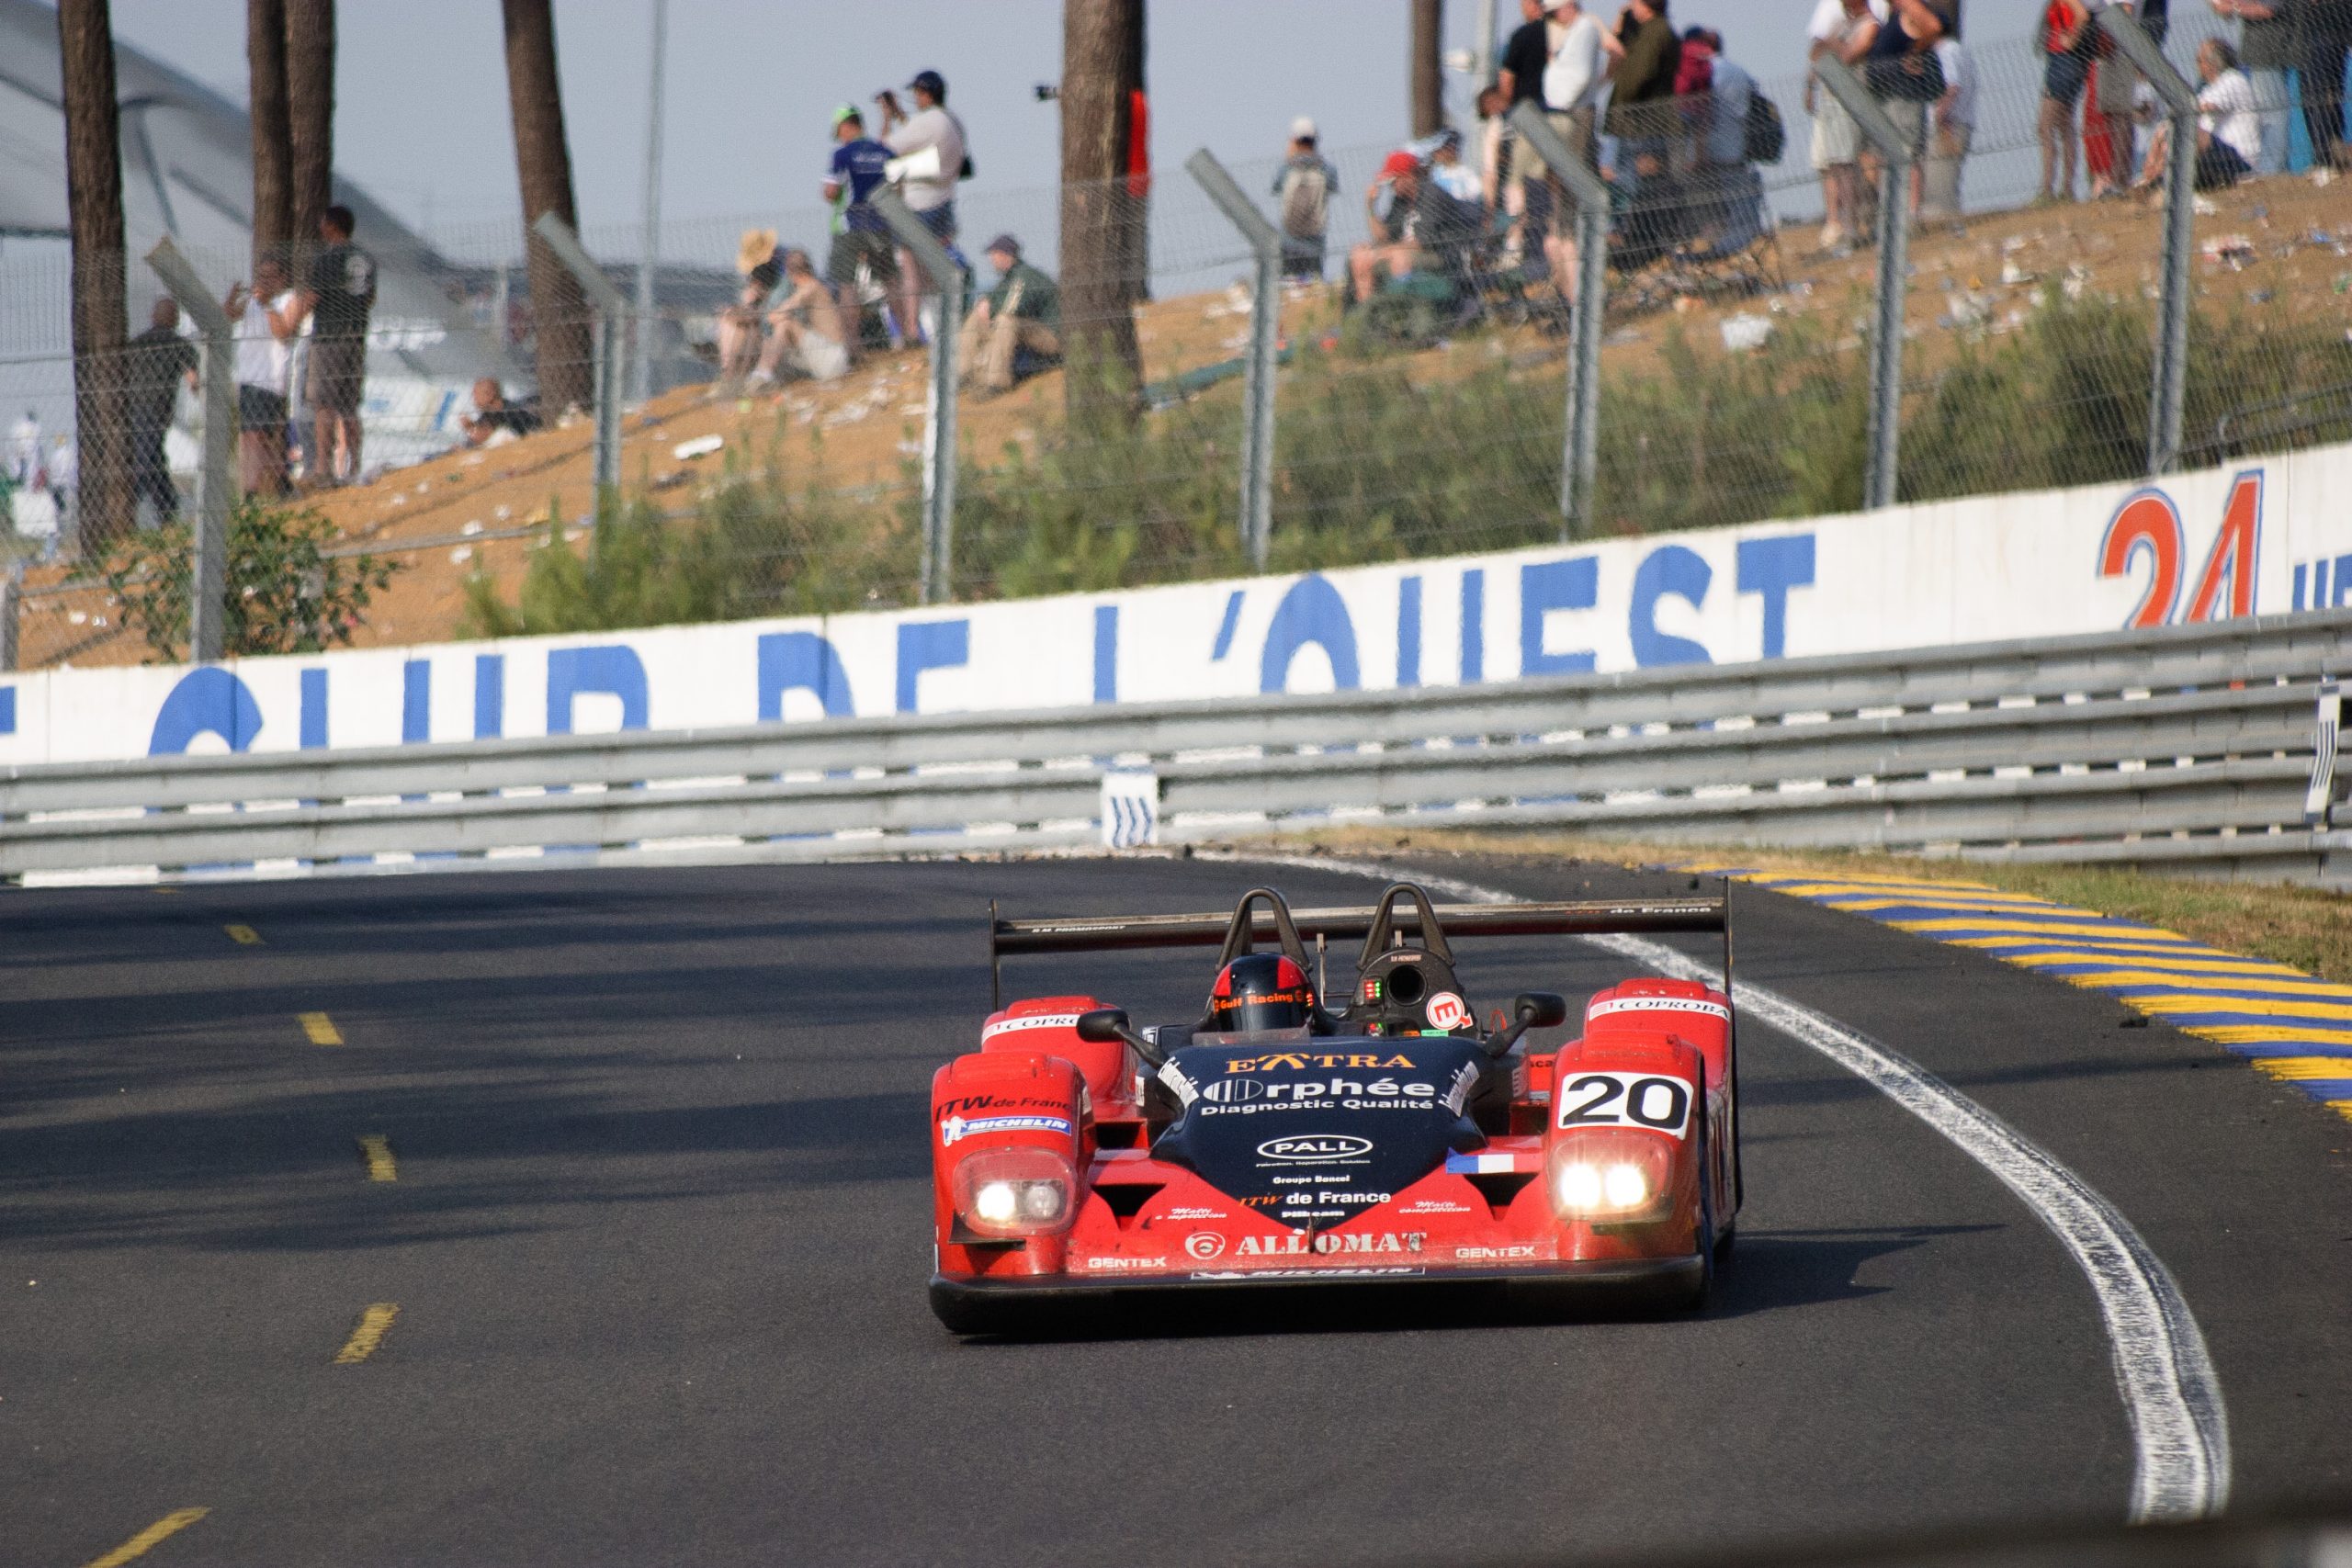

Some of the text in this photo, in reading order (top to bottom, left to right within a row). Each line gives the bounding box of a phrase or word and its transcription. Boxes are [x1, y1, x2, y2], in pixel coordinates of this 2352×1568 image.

[1219, 993, 1294, 1010] Gulf Racing
[1202, 1099, 1434, 1115] Diagnostic Qualité
[1563, 1076, 1689, 1130] 20
[968, 1118, 1067, 1131] MICHELIN
[1275, 1143, 1356, 1154] PALL
[1286, 1192, 1312, 1204] de
[1319, 1191, 1391, 1203] France
[1456, 1247, 1534, 1258] GENTEX
[1089, 1257, 1166, 1269] GENTEX
